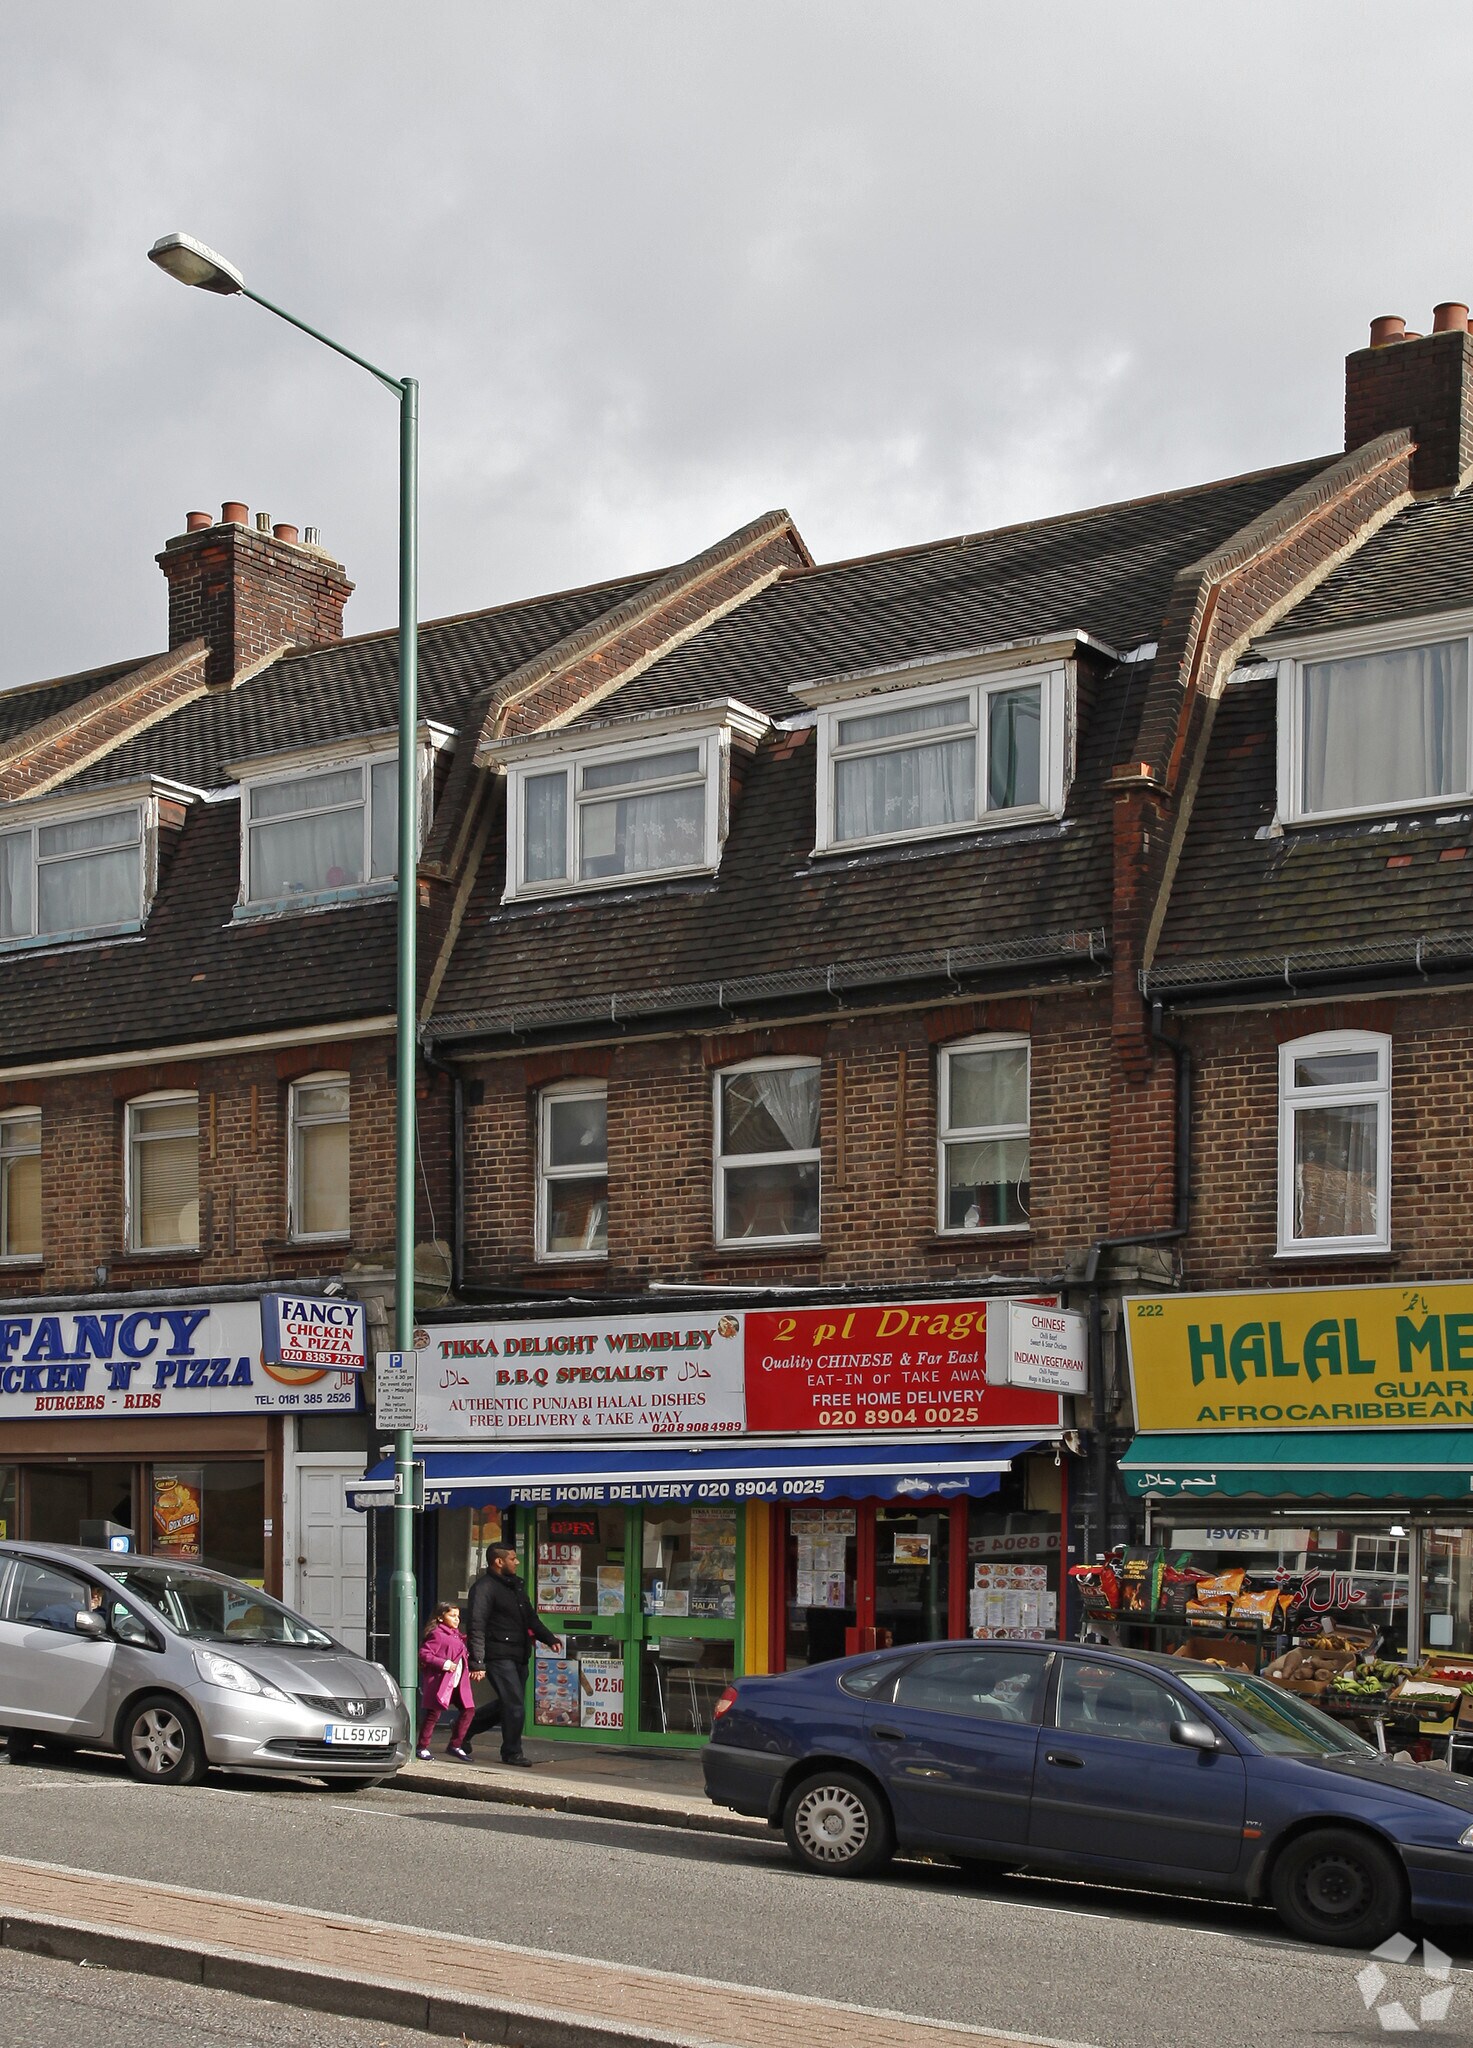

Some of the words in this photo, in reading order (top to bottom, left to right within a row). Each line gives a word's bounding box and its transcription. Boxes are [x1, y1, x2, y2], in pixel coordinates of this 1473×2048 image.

[281, 1301, 358, 1326] FANCY
[1137, 1305, 1164, 1317] 222
[287, 1323, 353, 1340] CHICKEN
[773, 1318, 797, 1341] 2
[1031, 1316, 1066, 1332] CHINESE
[0, 1309, 210, 1362] FANCY
[290, 1336, 303, 1348] &
[308, 1338, 351, 1352] PIZZA
[437, 1338, 499, 1359] TIKKA
[503, 1336, 598, 1358] DELIGHT
[604, 1329, 717, 1354] WEMBLEY
[283, 1350, 303, 1360] 020
[306, 1352, 332, 1363] 8385
[335, 1355, 360, 1365] 2526
[392, 1355, 400, 1367] P
[762, 1355, 813, 1371] Quality
[816, 1353, 893, 1369] CHINESE
[899, 1352, 911, 1366] &
[916, 1351, 943, 1365] Far
[947, 1351, 979, 1364] East
[1014, 1351, 1040, 1364] INDIAN
[1041, 1355, 1084, 1371] VEGETARIAN
[1187, 1318, 1376, 1387] HALAL
[152, 1357, 253, 1389] PIZZA
[439, 1369, 470, 1389] حلال
[495, 1367, 549, 1388] B.B.Q
[555, 1364, 668, 1384] SPECIALIST
[678, 1361, 712, 1381] حلال
[807, 1373, 863, 1386] EAT-IN
[873, 1373, 891, 1385] or
[902, 1370, 940, 1383] TAKE
[950, 1369, 987, 1382] AWAY
[812, 1393, 852, 1406] FREE
[857, 1391, 901, 1406] HOME
[906, 1389, 985, 1405] DELIVERY
[1375, 1381, 1473, 1398] GUAR
[34, 1395, 105, 1411] BURGERS
[123, 1393, 162, 1409] RIBS
[255, 1395, 274, 1405] TEL:
[278, 1394, 300, 1405] 0181
[303, 1394, 322, 1404] 385
[326, 1392, 351, 1403] 2526
[449, 1397, 528, 1412] AUTHENTIC
[533, 1396, 592, 1410] PUNJABI
[597, 1394, 647, 1409] HALAL
[651, 1392, 706, 1407] DISHES
[469, 1414, 504, 1427] FREE
[507, 1413, 578, 1427] DELIVERY
[582, 1413, 591, 1425] &
[595, 1412, 634, 1425] TAKE
[637, 1410, 682, 1424] AWAY
[818, 1411, 856, 1426] 020
[864, 1409, 917, 1425] 8904
[924, 1408, 979, 1424] 0025
[1197, 1401, 1473, 1421] AFROCARIBBEAN
[651, 1423, 675, 1433] 020
[711, 1422, 742, 1432] 4989
[1137, 1472, 1176, 1488] حلال
[1180, 1473, 1217, 1490] لحم
[510, 1488, 552, 1501] FREE
[555, 1486, 604, 1500] HOME
[609, 1483, 693, 1499] DELIVERY
[698, 1482, 730, 1497] 020
[734, 1480, 778, 1496] 8904
[782, 1479, 825, 1494] 0025
[551, 1520, 595, 1535] OPEN
[540, 1543, 581, 1560] £1.99
[1309, 1569, 1367, 1612] حلال
[595, 1677, 624, 1693] £2.50
[595, 1711, 624, 1727] £3.99
[334, 1727, 365, 1741] LL59
[367, 1729, 388, 1742] XSP
